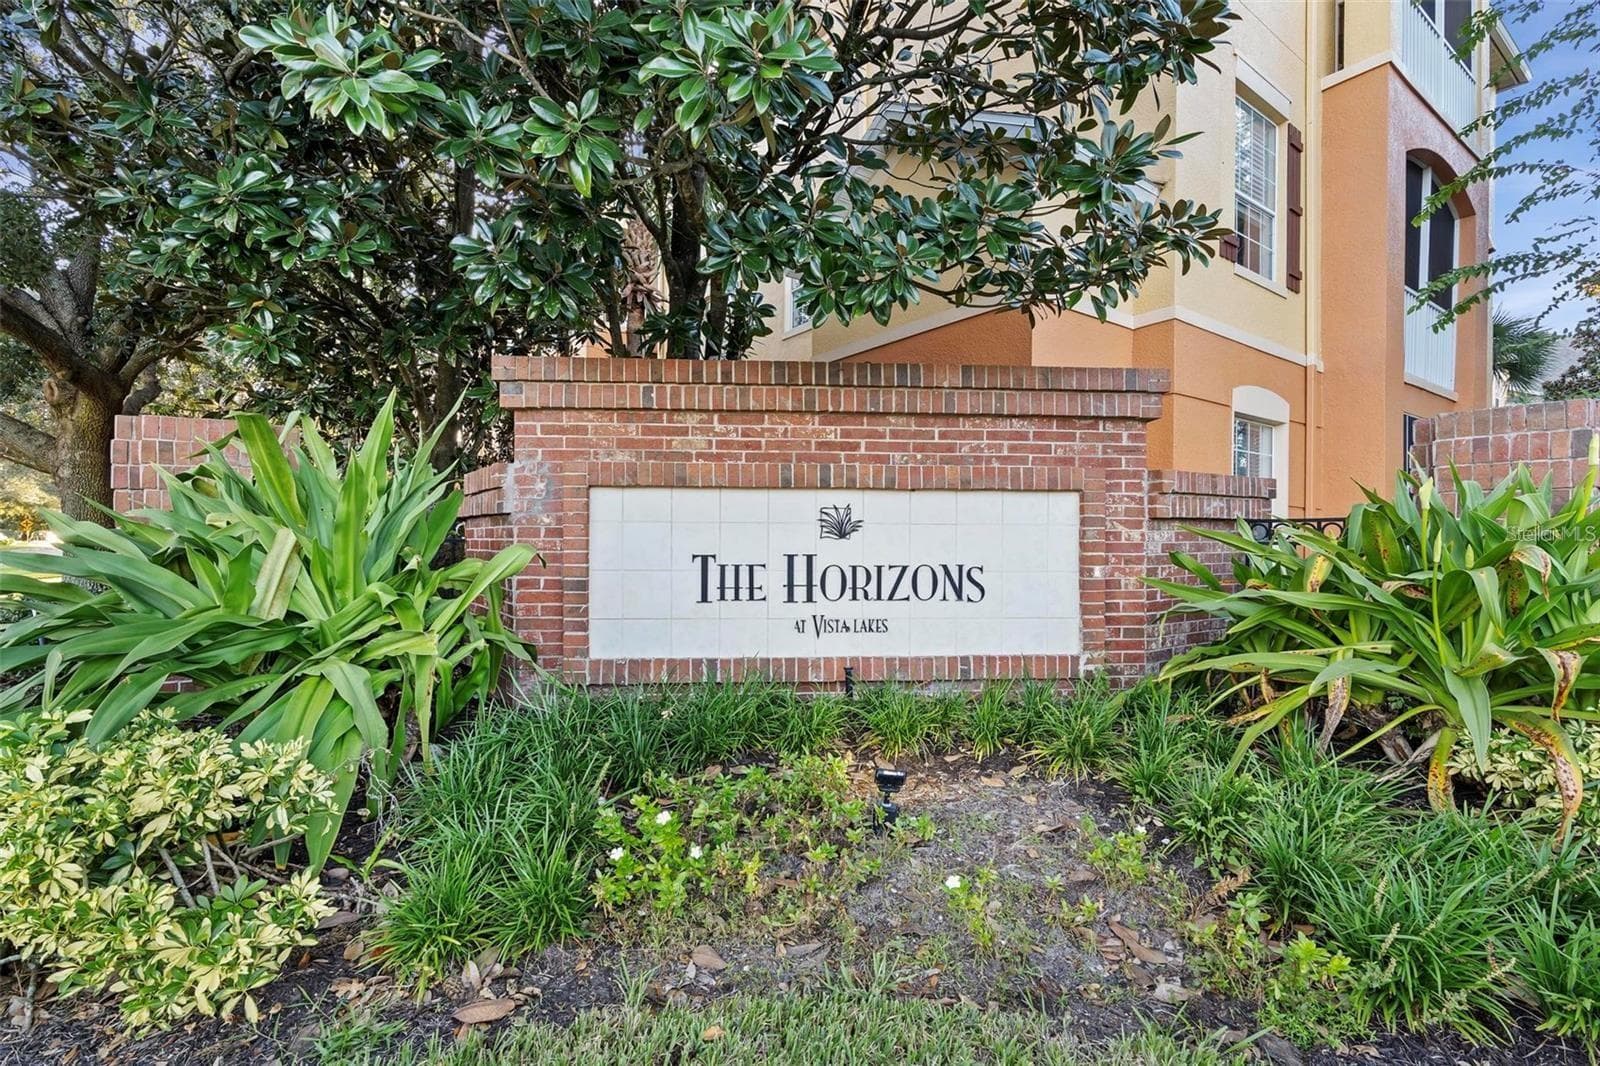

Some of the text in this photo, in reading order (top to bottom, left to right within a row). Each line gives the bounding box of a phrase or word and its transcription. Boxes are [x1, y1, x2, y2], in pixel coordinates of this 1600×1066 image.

[691, 553, 986, 604] THE HORIZONS
[794, 615, 889, 640] AT VISTA LAKES
